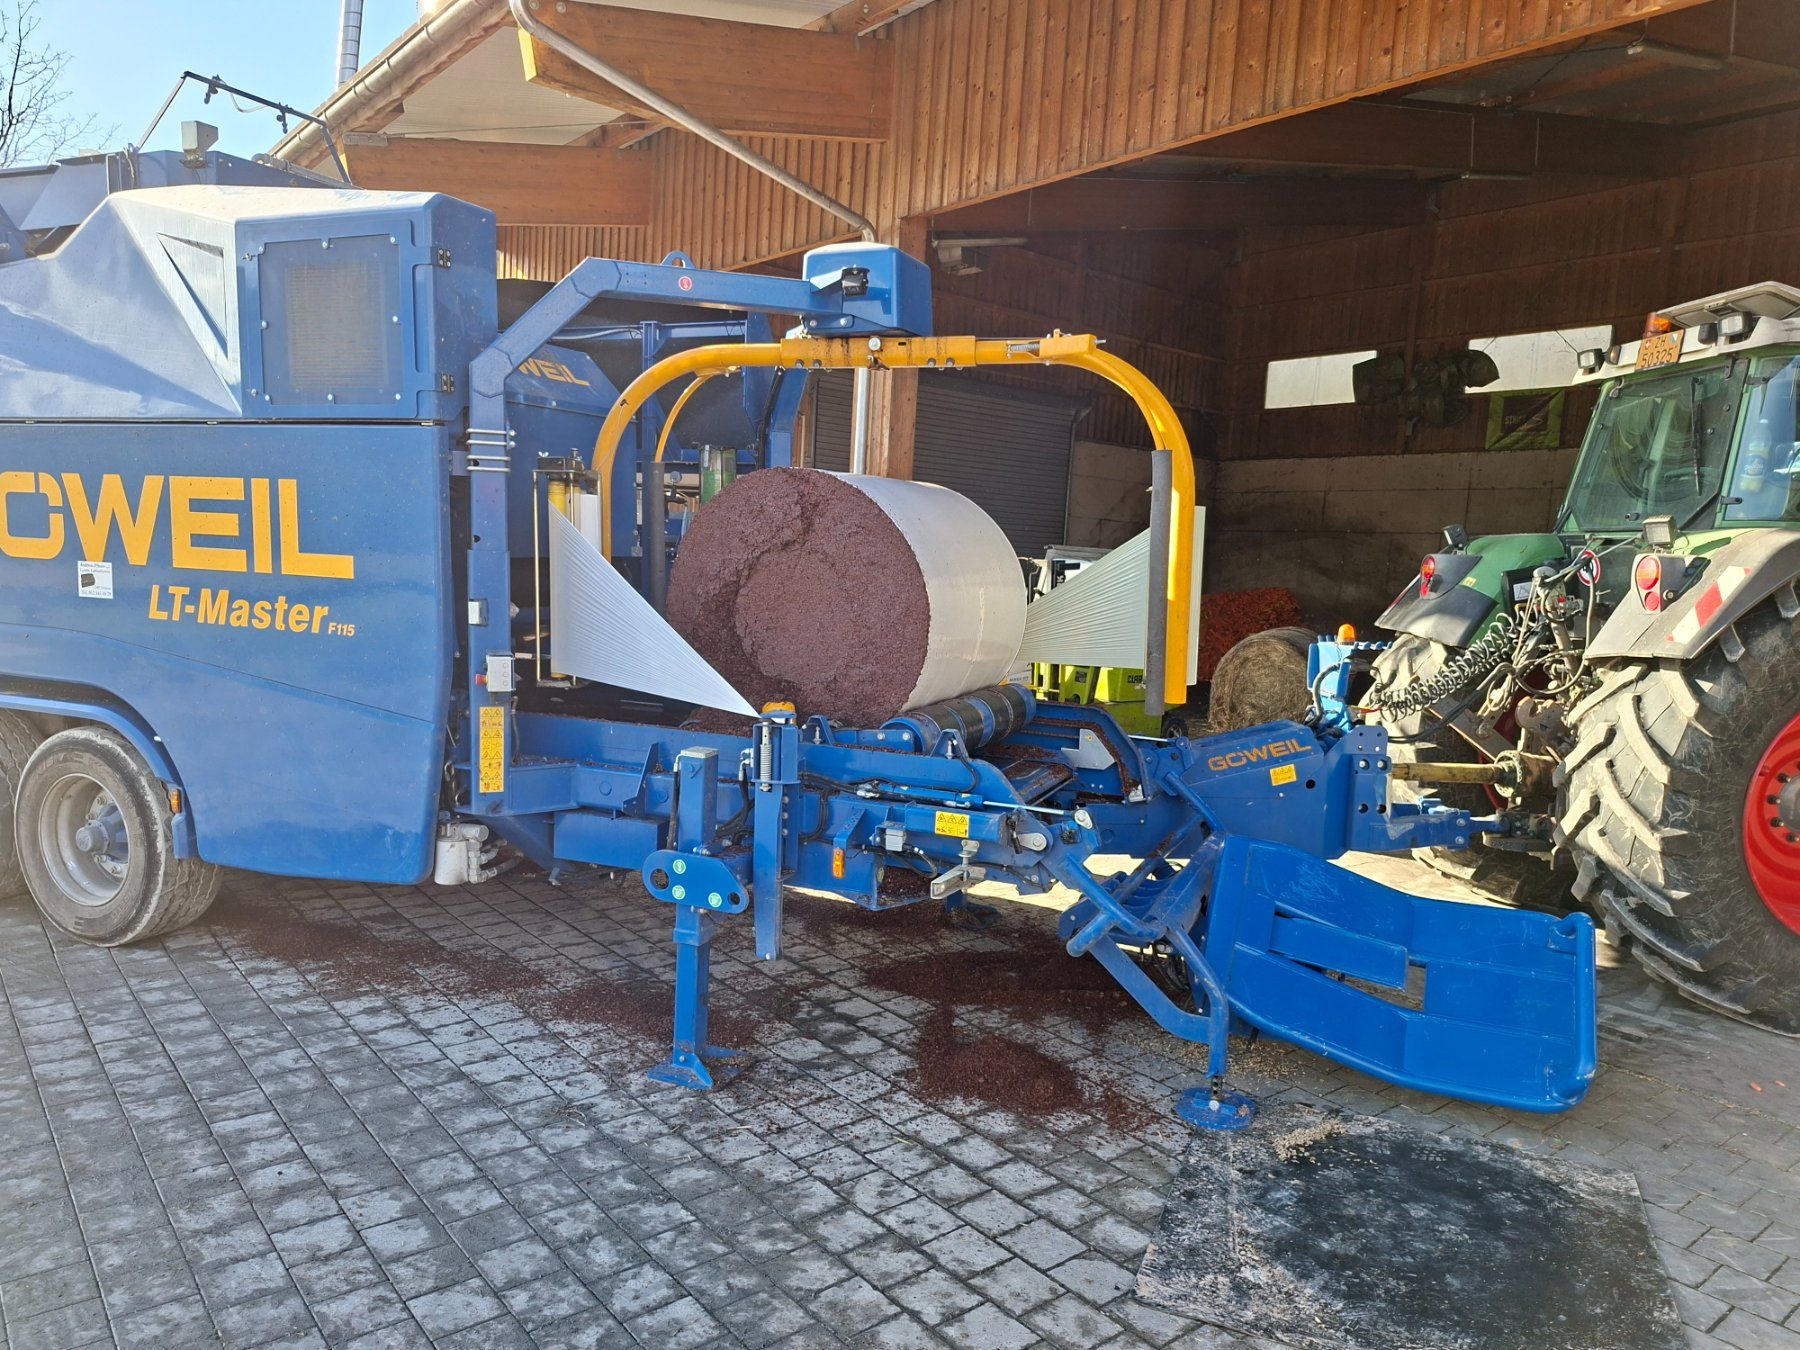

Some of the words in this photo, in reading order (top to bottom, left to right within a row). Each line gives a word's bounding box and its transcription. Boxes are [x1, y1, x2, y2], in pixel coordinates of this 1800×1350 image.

[1655, 336, 1667, 348] ZH
[1641, 347, 1673, 368] 50325
[519, 358, 591, 386] WEIL
[0, 471, 354, 579] OWEIL
[149, 585, 329, 634] LT-Master
[328, 622, 356, 637] F115
